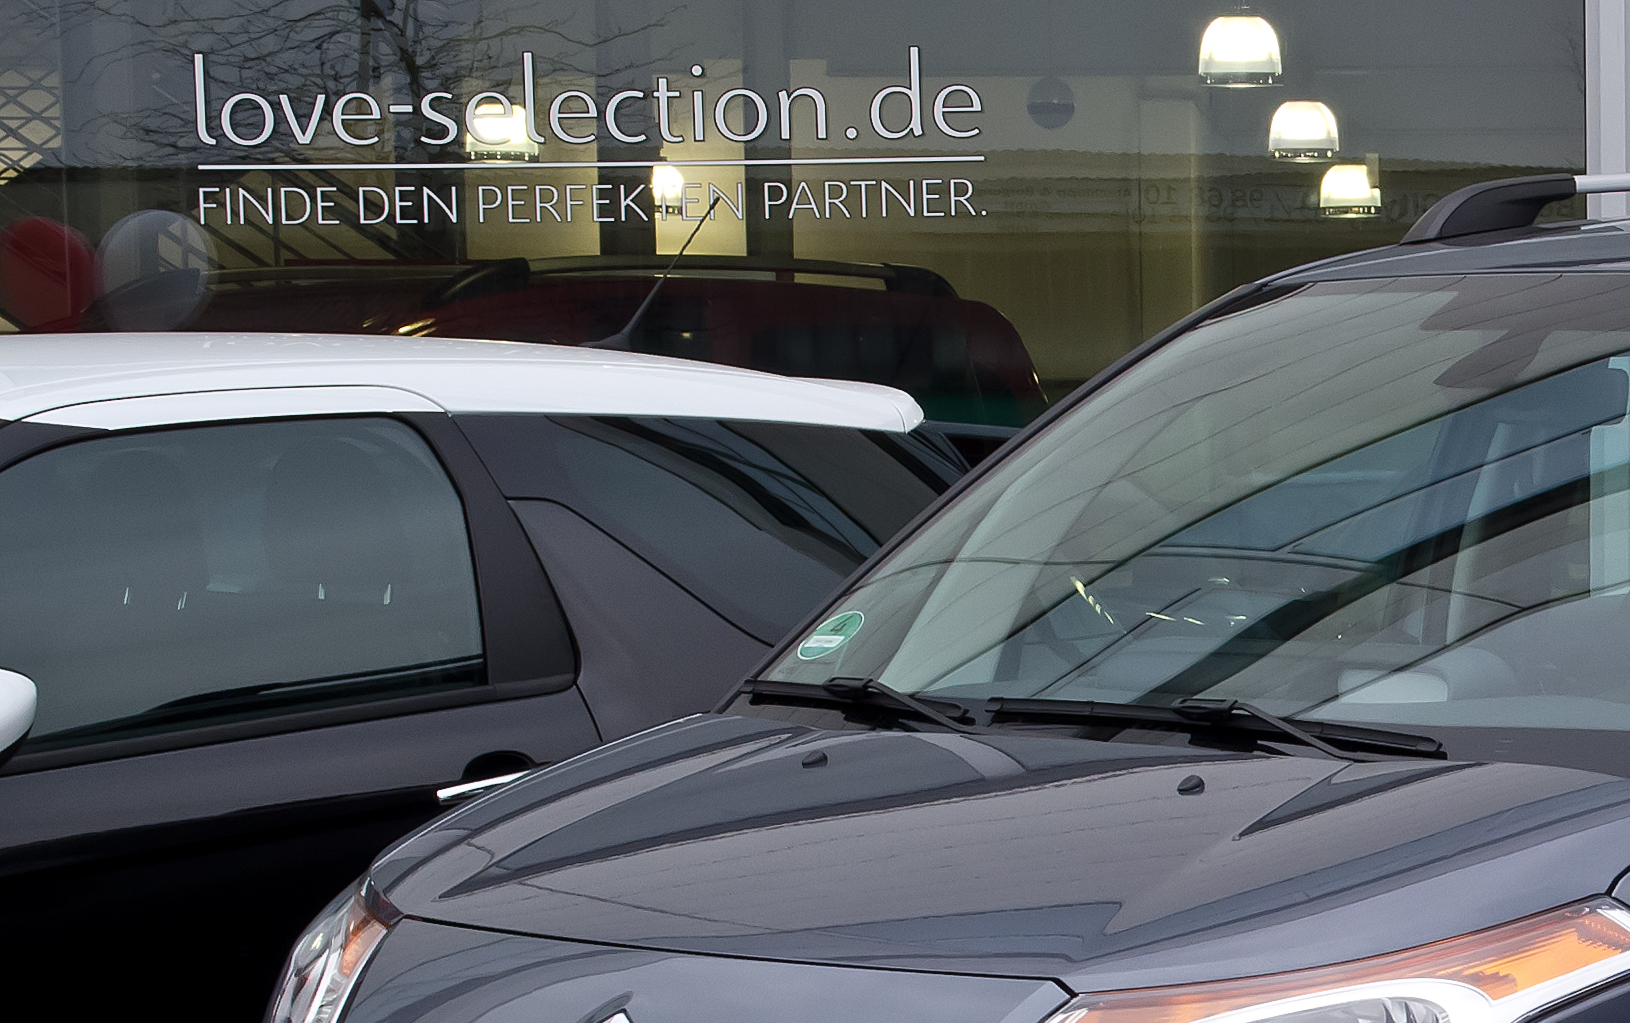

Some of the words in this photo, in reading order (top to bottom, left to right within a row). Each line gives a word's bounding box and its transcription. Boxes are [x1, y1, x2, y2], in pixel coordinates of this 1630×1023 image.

[194, 46, 984, 147] love-selection.de
[199, 185, 338, 226] FINDE
[359, 185, 458, 225] DEN
[765, 178, 989, 220] PARTNER.
[829, 614, 854, 633] 4
